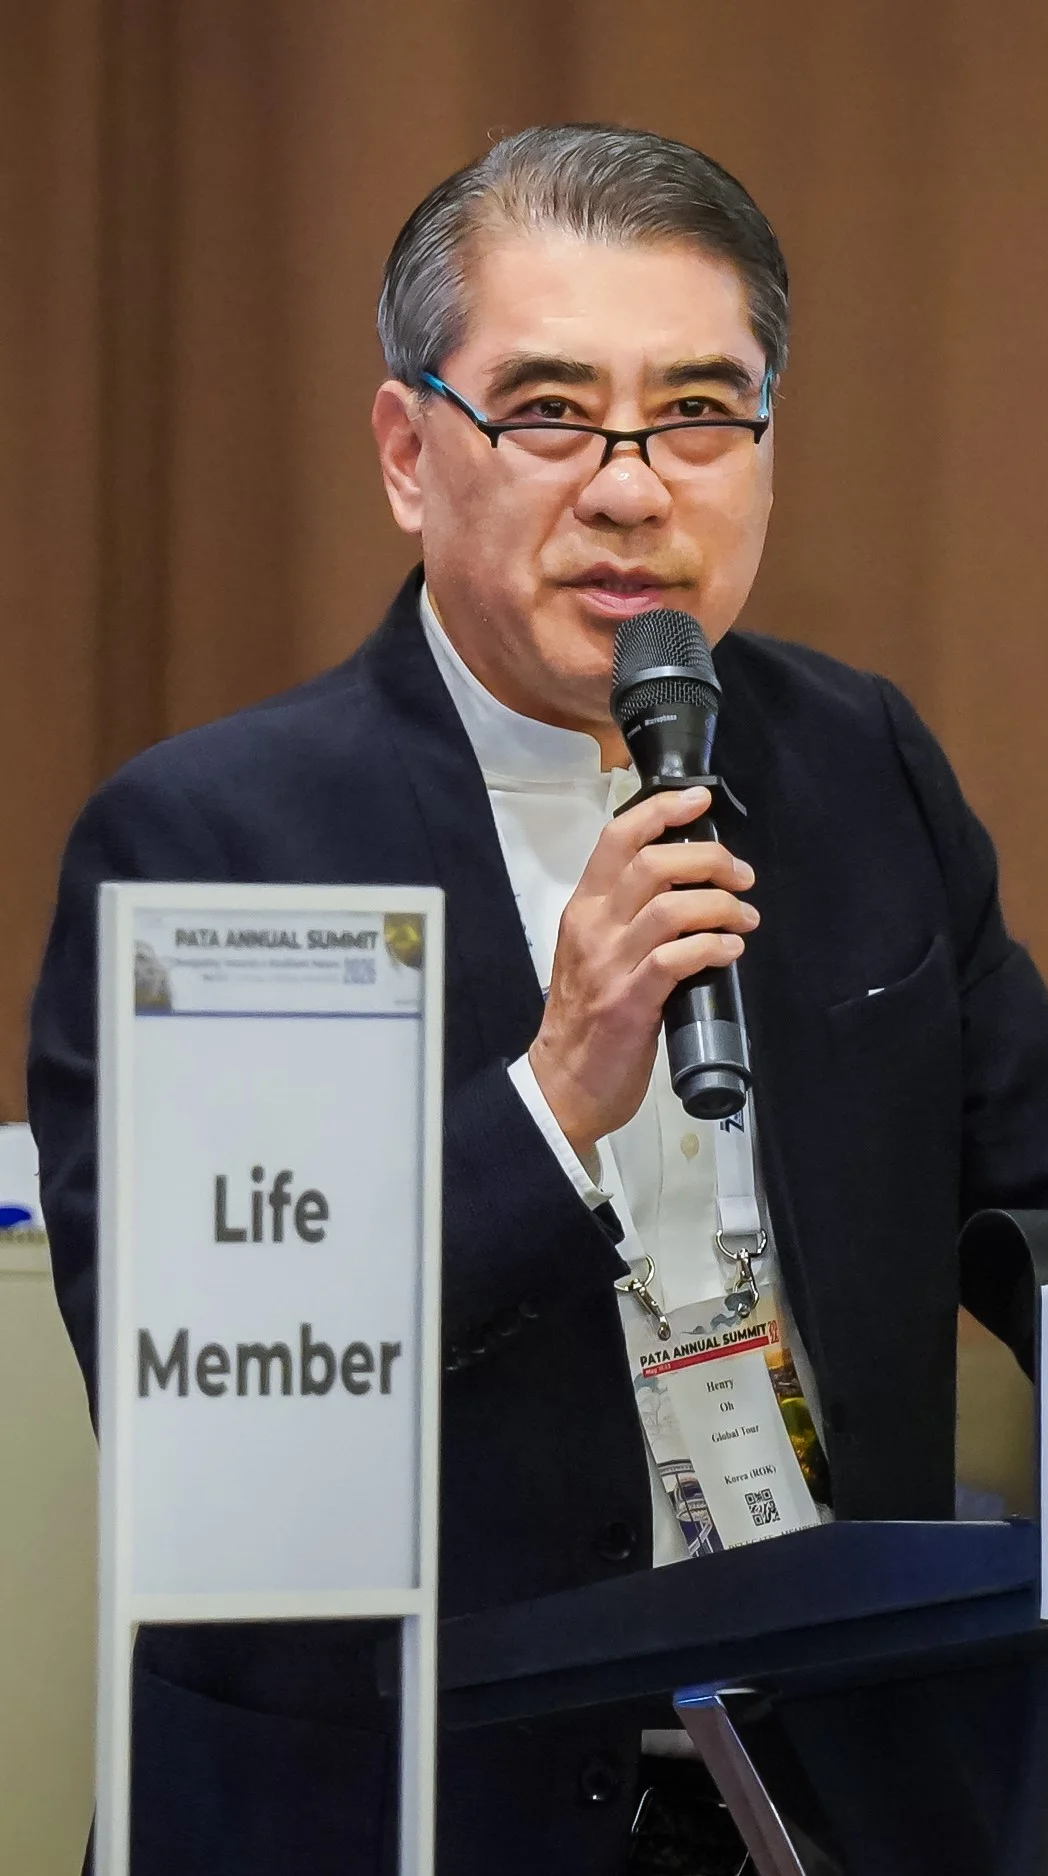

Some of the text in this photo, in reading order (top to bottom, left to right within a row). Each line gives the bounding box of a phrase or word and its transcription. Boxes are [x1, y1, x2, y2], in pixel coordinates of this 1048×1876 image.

[214, 1165, 330, 1243] Life
[639, 1350, 671, 1367] PATA
[673, 1337, 721, 1358] ANNUAL
[723, 1323, 768, 1346] SUMMIT
[137, 1322, 403, 1397] Member
[706, 1378, 734, 1393] Henry
[719, 1402, 735, 1412] Oh
[711, 1425, 760, 1443] Global Tour
[724, 1464, 777, 1485] Korea (ROK)
